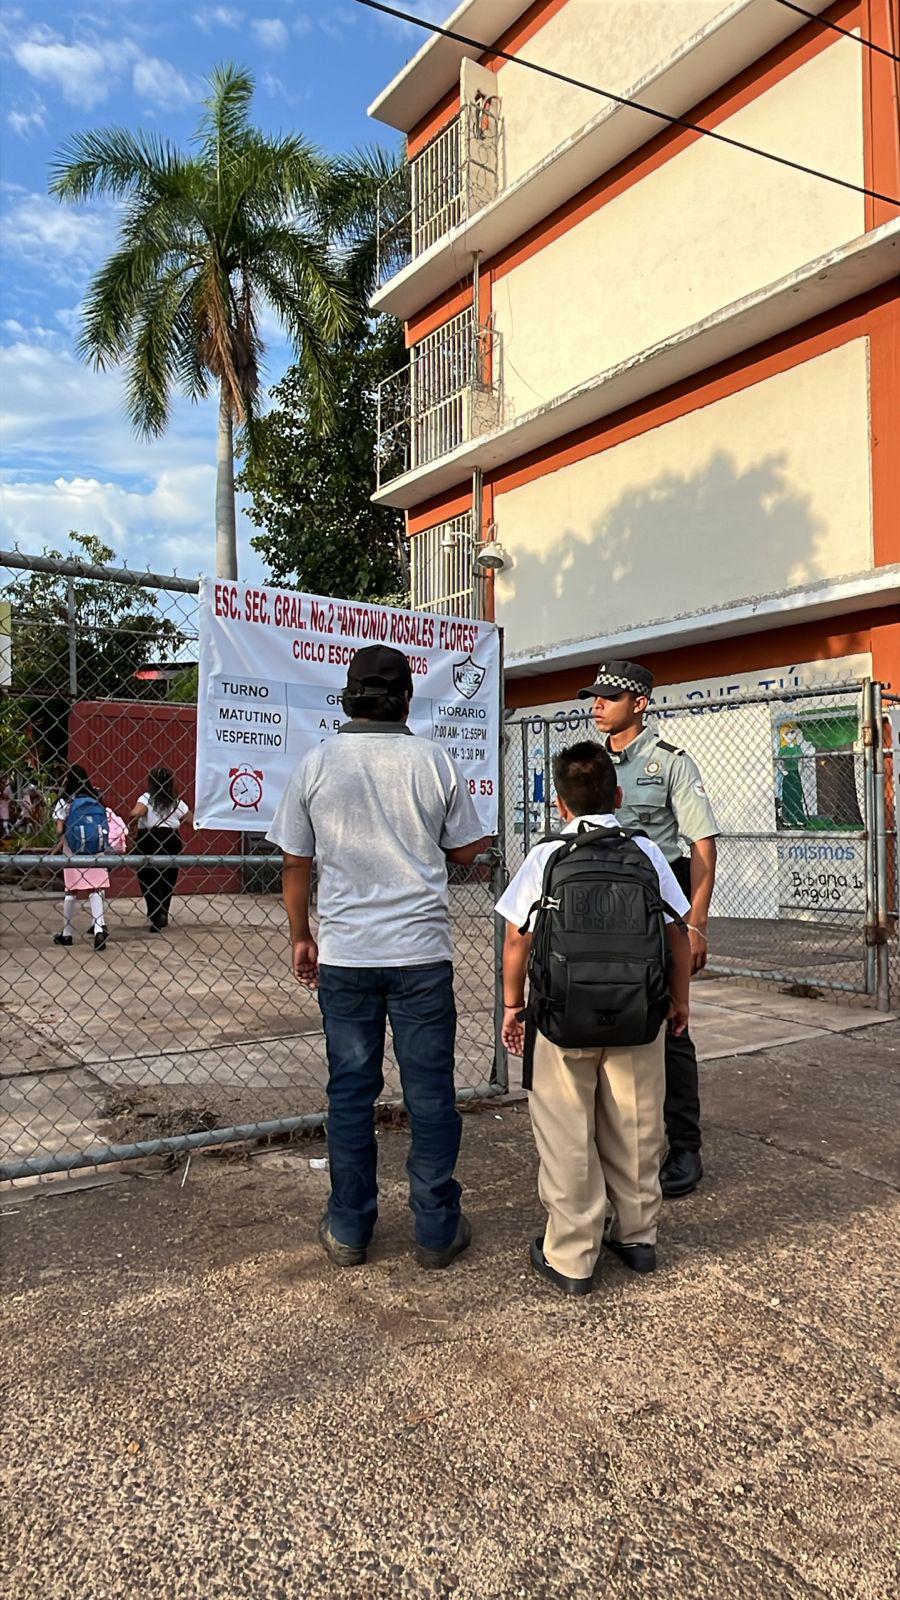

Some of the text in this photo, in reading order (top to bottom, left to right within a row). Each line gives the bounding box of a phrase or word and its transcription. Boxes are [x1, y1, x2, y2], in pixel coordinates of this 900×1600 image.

[214, 584, 241, 620] ESC.
[245, 589, 271, 625] SEC.
[274, 594, 307, 631] GRAL.
[310, 600, 334, 634] No.2
[390, 613, 434, 648] ROSALES
[292, 640, 325, 662] CICLO
[406, 655, 428, 675] 026
[221, 682, 269, 698] TURNO
[219, 707, 282, 725] MATUTINO
[438, 706, 487, 719] HORARIO
[216, 729, 282, 747] VESPERTINO
[434, 725, 447, 738] 7:00
[461, 728, 487, 740] 12:55PM
[475, 749, 485, 760] PM
[480, 780, 494, 795] 53
[788, 844, 855, 861] mismos
[572, 886, 638, 917] BOY
[793, 888, 841, 903] Angulo
